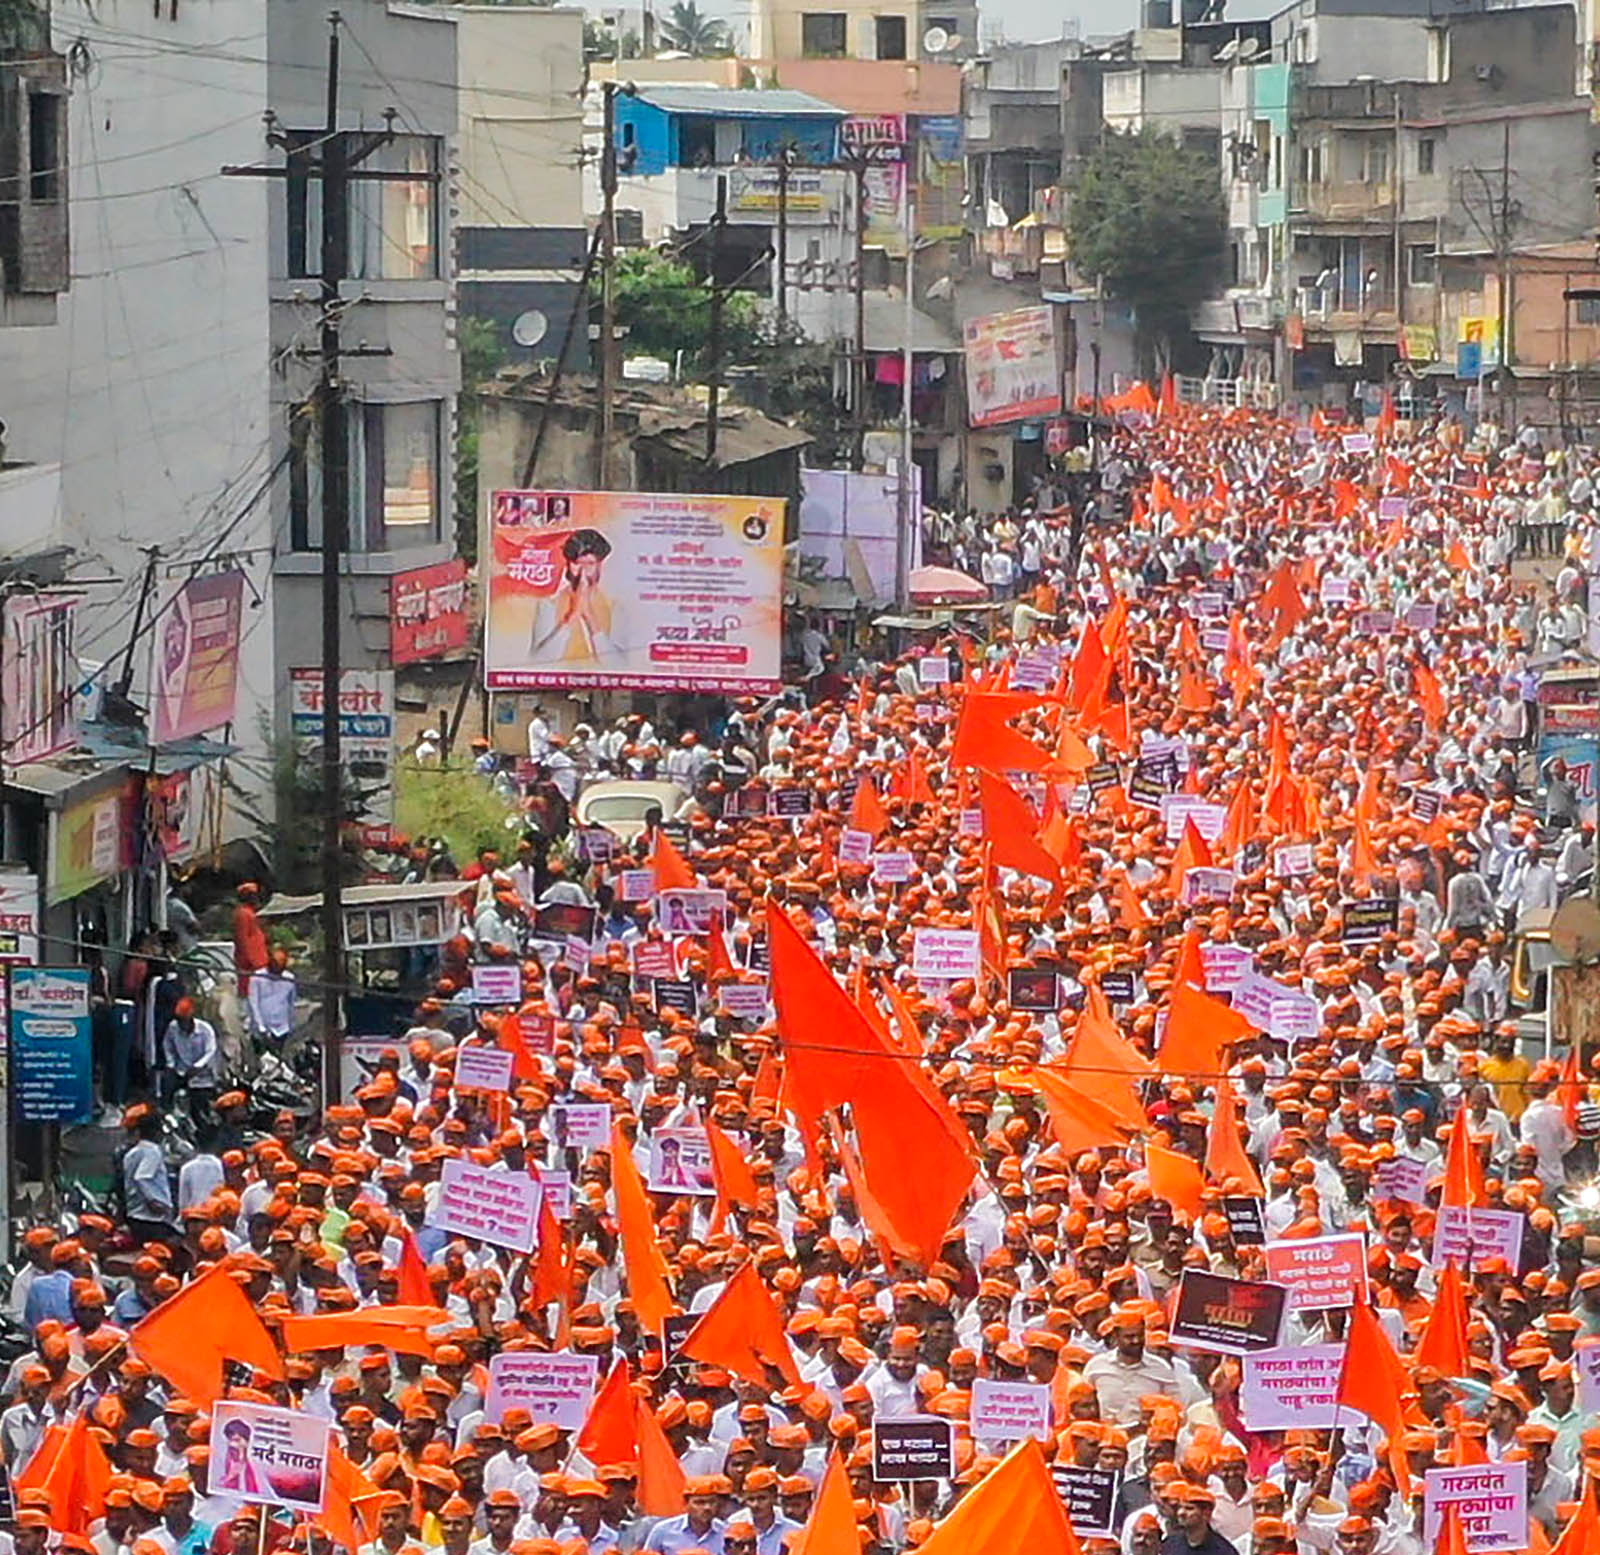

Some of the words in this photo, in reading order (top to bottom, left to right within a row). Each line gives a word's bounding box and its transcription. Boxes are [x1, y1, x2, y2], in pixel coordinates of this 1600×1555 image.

[250, 1444, 276, 1467] मर्द
[278, 1448, 324, 1473] मराठा
[1441, 1469, 1506, 1492] गरजवंत
[1433, 1492, 1517, 1514] माठ्यांचा
